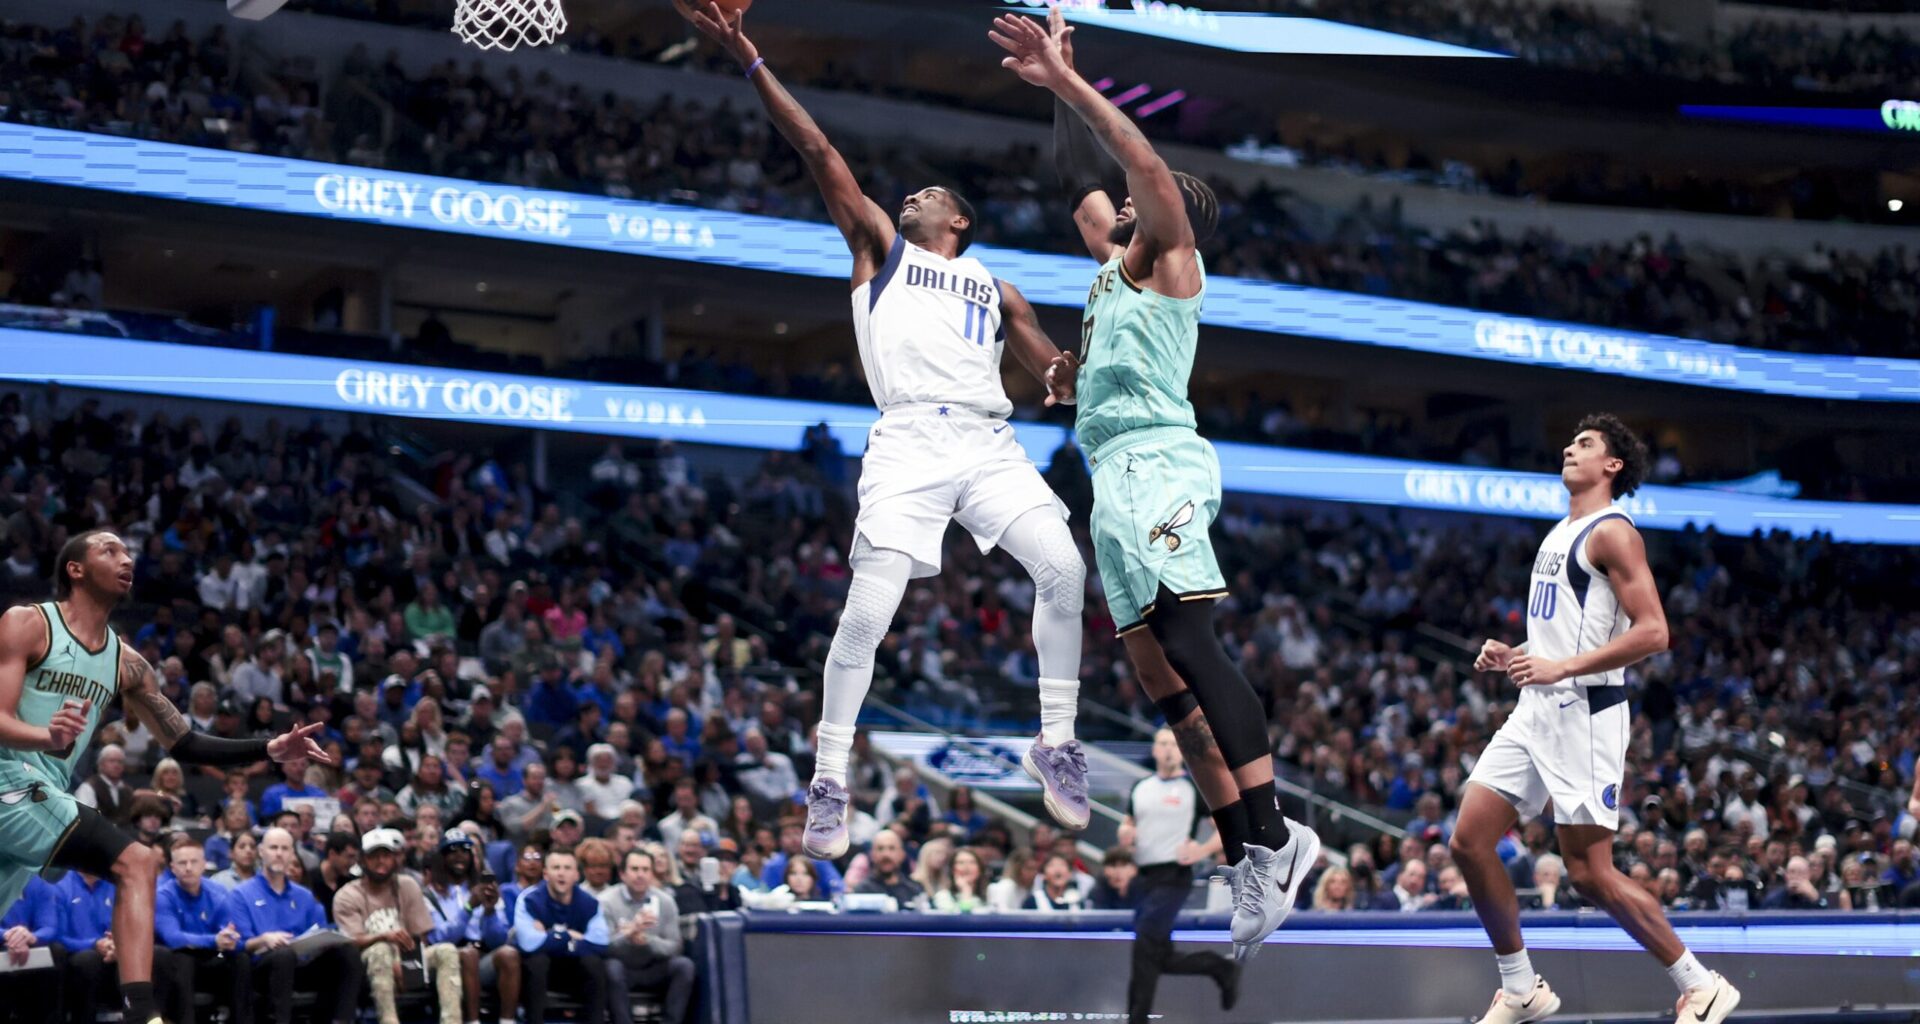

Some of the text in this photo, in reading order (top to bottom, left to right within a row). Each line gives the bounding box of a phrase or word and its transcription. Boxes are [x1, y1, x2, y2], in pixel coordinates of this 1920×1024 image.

[314, 173, 716, 248] GREY GOOSE VODKA
[906, 264, 993, 305] DALLAS
[963, 299, 989, 346] 11
[1474, 318, 1545, 359] GREY
[1551, 327, 1646, 372] GOOSE
[336, 368, 707, 429] GREY GOOSE VODKA
[1404, 468, 1471, 506] GREY
[1476, 475, 1569, 515] GOOSE
[1532, 550, 1566, 577] ALLAS
[1530, 581, 1557, 620] 00
